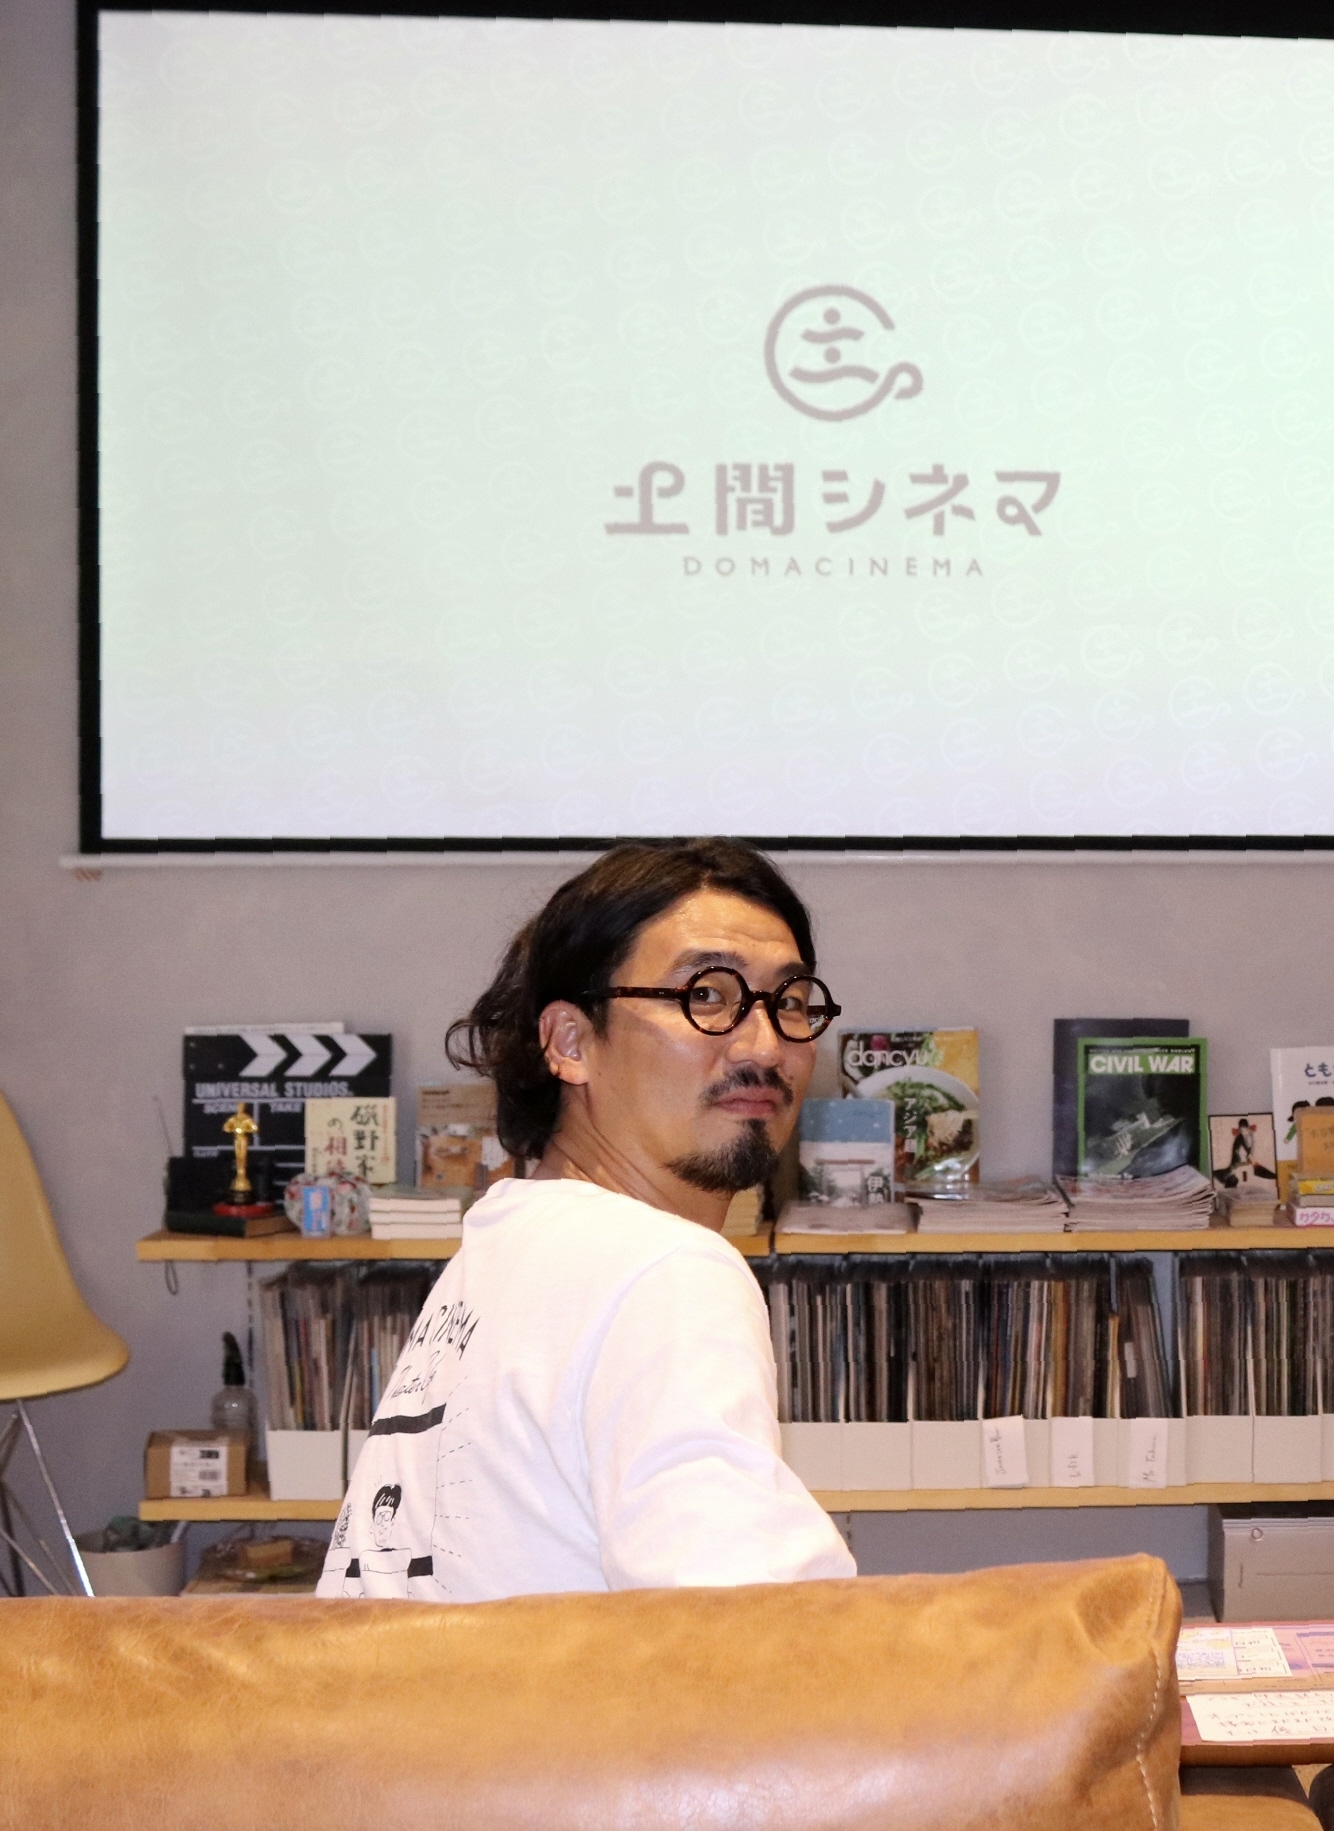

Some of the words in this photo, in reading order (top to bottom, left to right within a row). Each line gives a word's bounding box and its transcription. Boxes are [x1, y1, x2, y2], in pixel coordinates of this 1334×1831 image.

[604, 461, 1061, 536] 土間シネマ
[684, 556, 984, 577] DOMACINEMA
[847, 1041, 930, 1067] dancyu
[1090, 1055, 1143, 1073] CIVIL
[1148, 1055, 1194, 1074] WAR
[195, 1082, 278, 1098] UNIVERSAL
[203, 1102, 239, 1115] SCEN
